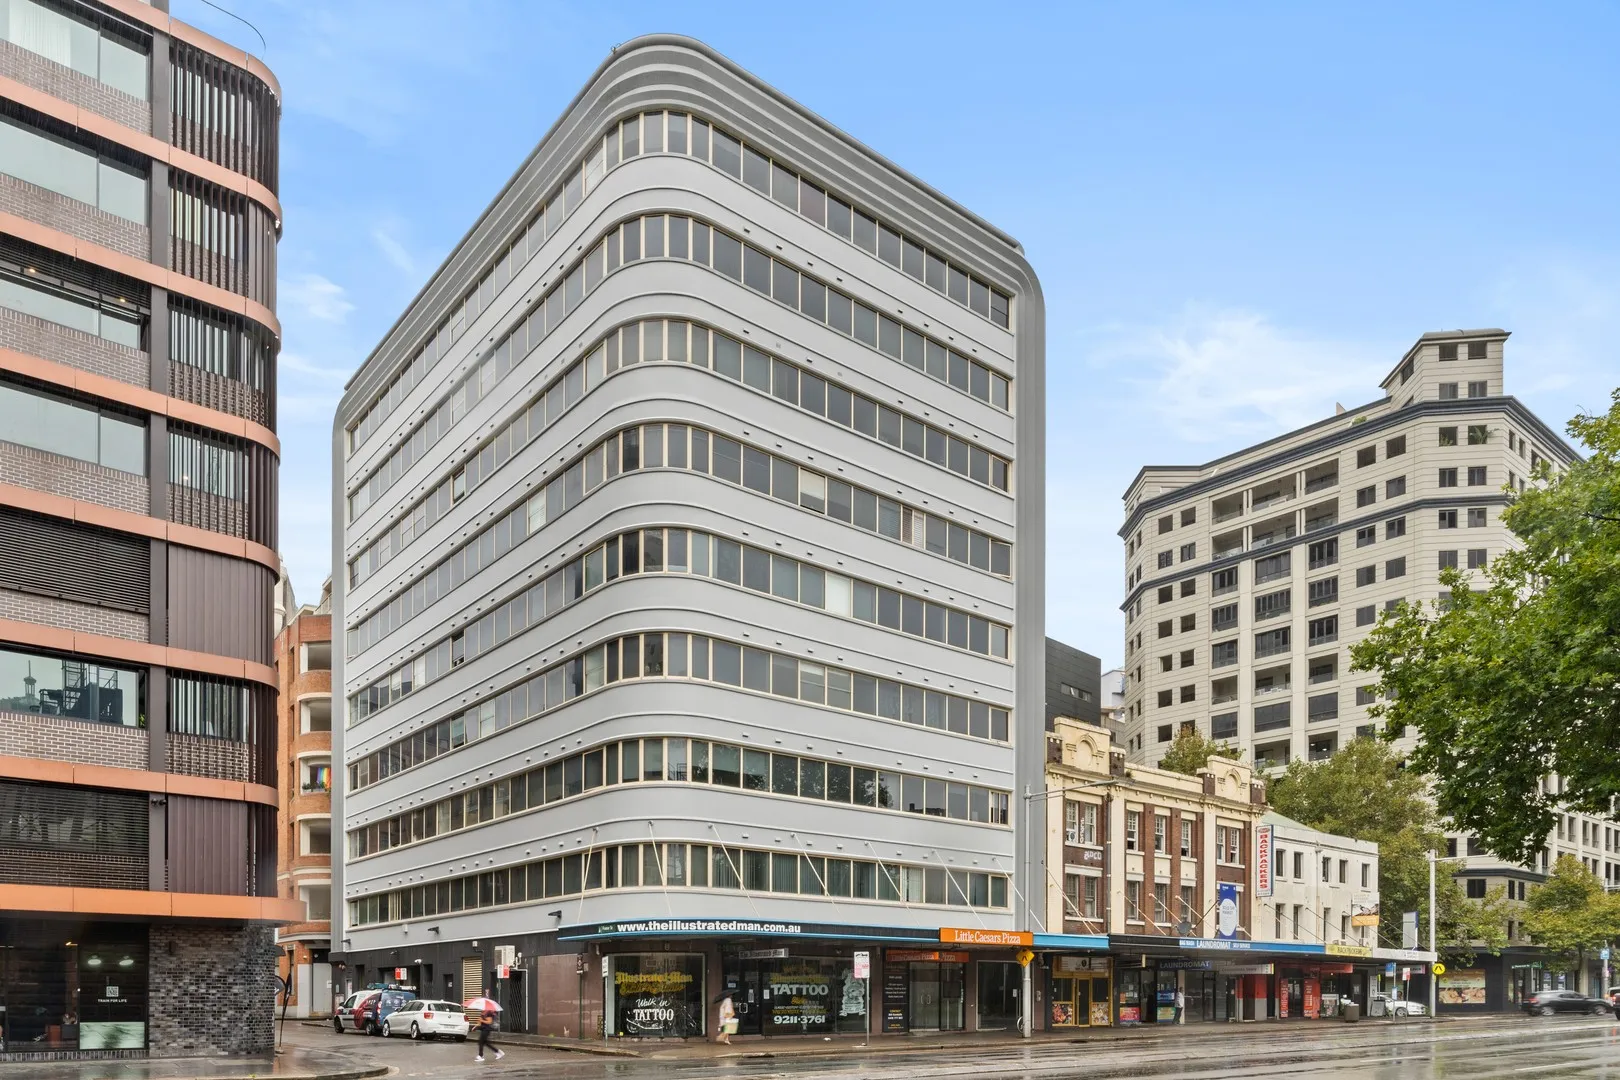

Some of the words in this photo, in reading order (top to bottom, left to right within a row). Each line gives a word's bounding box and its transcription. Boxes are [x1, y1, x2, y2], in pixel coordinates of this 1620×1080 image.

[1259, 834, 1268, 889] BACKPACKERS
[617, 920, 801, 933] www.theillustratedman.com.au
[954, 930, 974, 942] Little
[974, 931, 1001, 943] Caesars
[1002, 932, 1021, 944] Pizza
[1196, 940, 1231, 950] LAUNDROMAT
[1159, 960, 1210, 969] LAUNDROMAT
[770, 984, 829, 996] TATTOO
[635, 998, 657, 1008] Walk
[658, 998, 671, 1007] in
[633, 1008, 675, 1021] TATTOO
